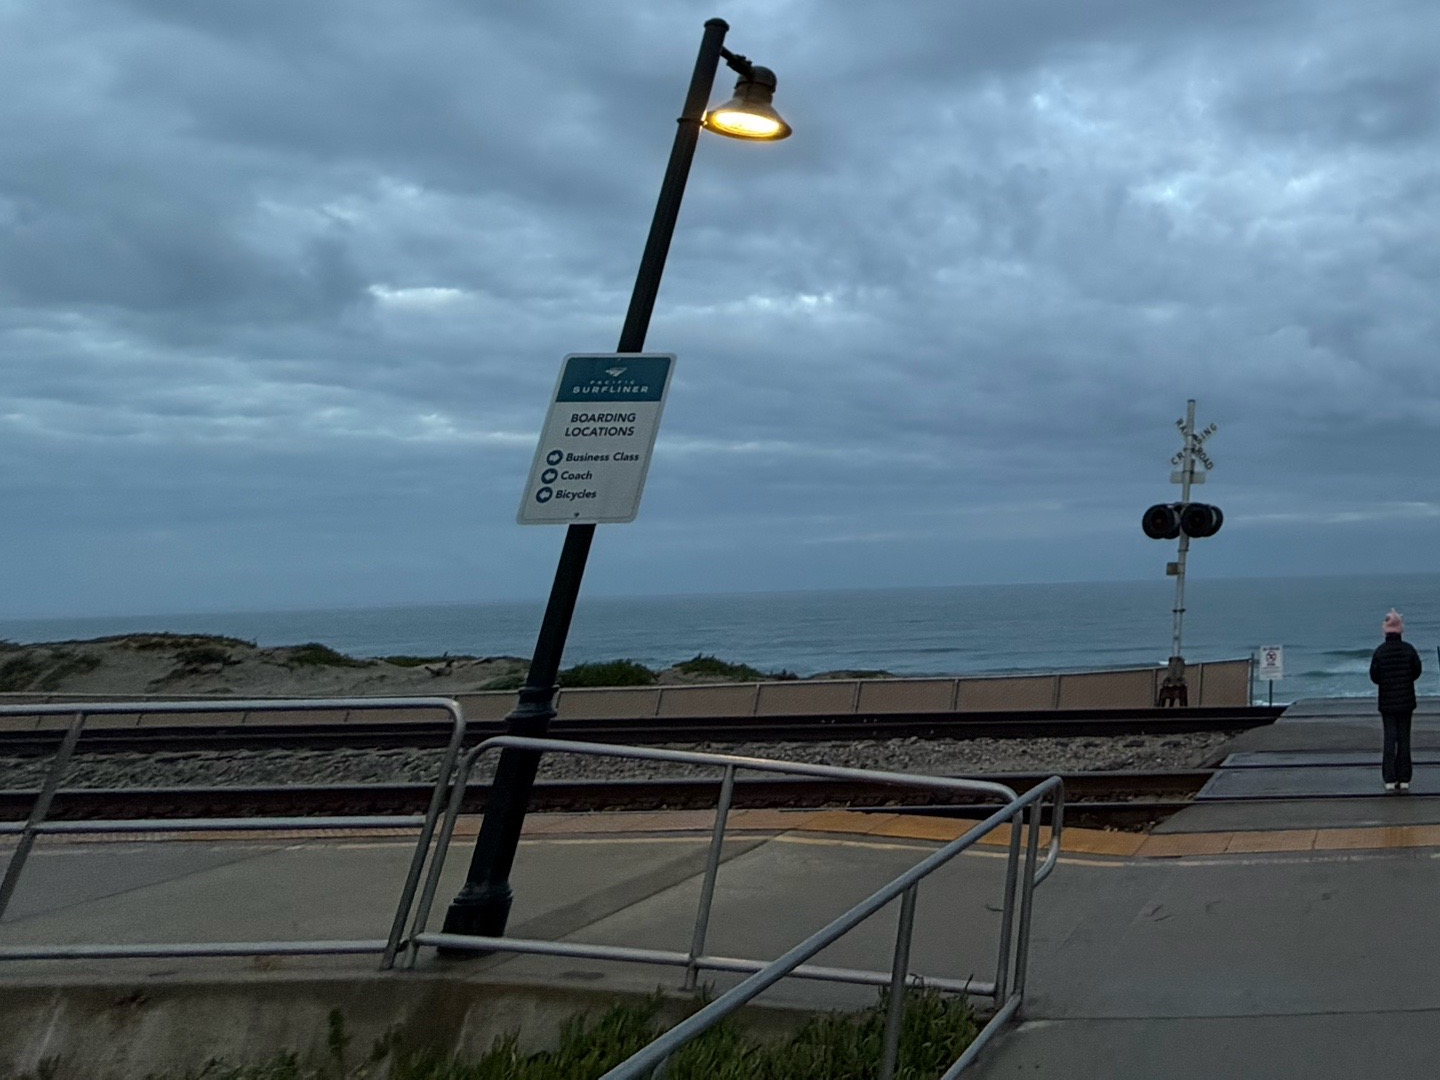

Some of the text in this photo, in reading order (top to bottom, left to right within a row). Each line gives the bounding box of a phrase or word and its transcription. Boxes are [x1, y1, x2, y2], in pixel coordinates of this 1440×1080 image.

[572, 385, 649, 394] SURFLINER
[570, 412, 637, 423] BOARDING
[564, 426, 635, 437] LOCATIONS
[565, 451, 640, 462] Business Class
[560, 470, 593, 481] Coach
[555, 489, 597, 501] Bicycles
